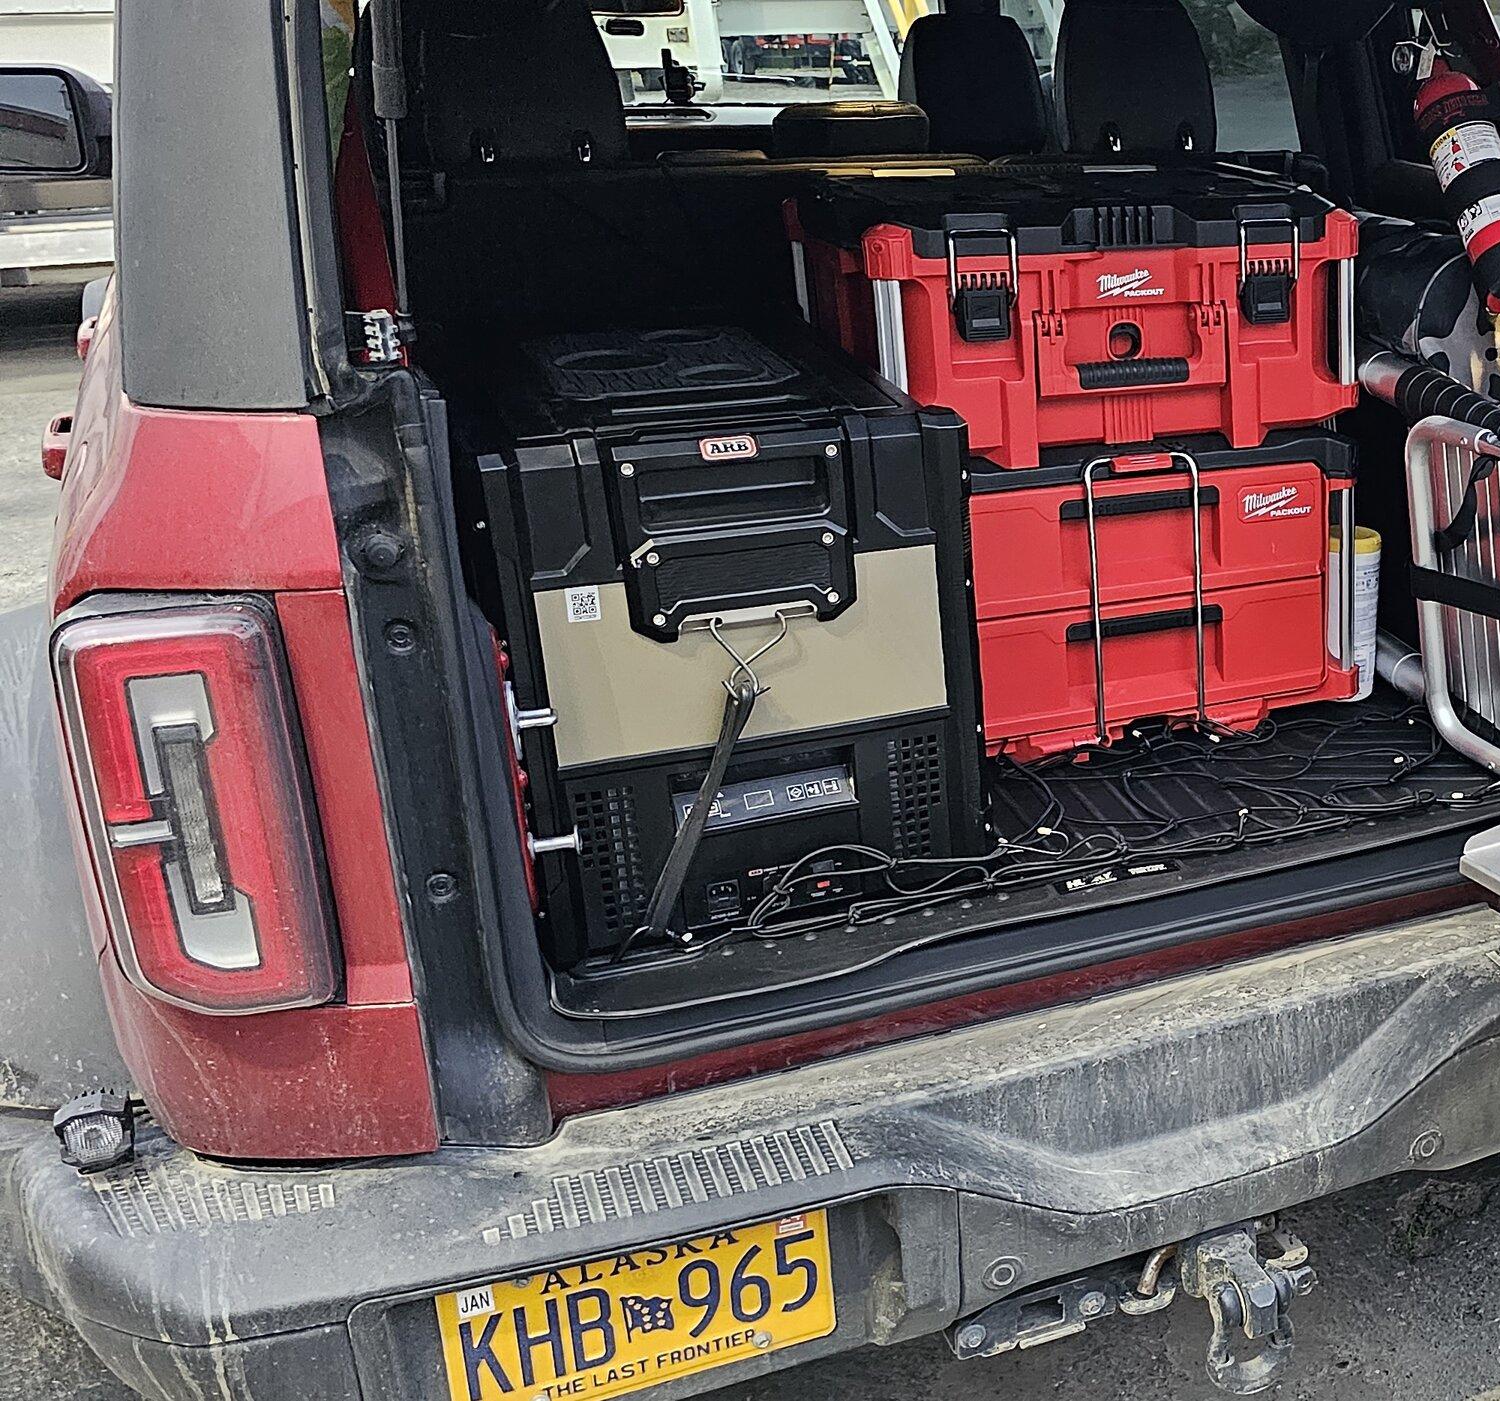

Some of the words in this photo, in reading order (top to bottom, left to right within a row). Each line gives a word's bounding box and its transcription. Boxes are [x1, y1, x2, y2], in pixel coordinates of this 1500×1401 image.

[1096, 269, 1150, 292] Milwaukee
[1123, 288, 1164, 297] PACKOUT
[709, 440, 749, 454] ARB
[1241, 486, 1298, 513] Milwaukee
[1270, 506, 1312, 517] PACKOUT
[540, 1230, 740, 1295] ALASKA
[460, 1291, 491, 1314] JAN
[458, 1288, 616, 1401] KHB
[677, 1229, 818, 1339] 965
[542, 1377, 587, 1398] THE
[593, 1358, 649, 1388] LAST
[656, 1329, 756, 1369] FRONTIER
